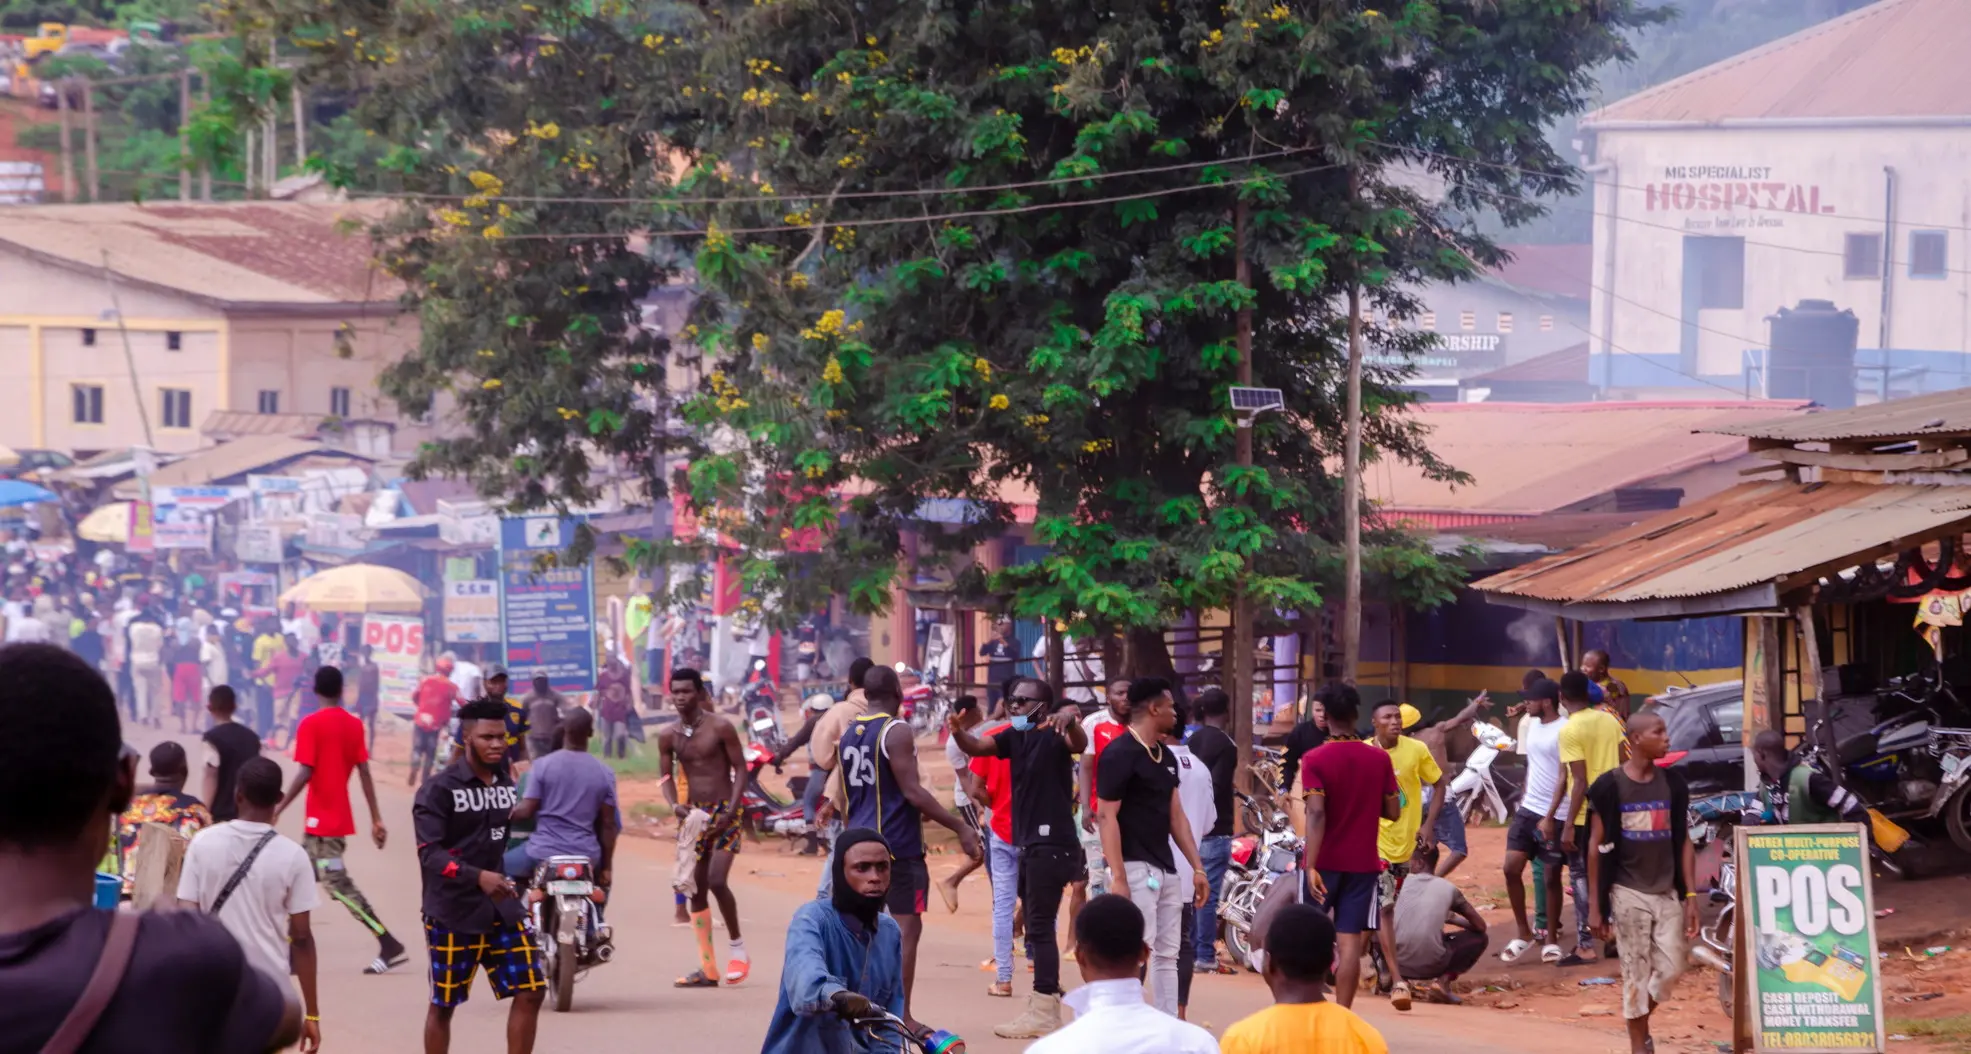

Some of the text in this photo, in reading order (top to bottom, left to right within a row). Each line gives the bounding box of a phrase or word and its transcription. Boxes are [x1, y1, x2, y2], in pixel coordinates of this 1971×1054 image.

[1689, 165, 1772, 179] SPECIALIST
[1646, 183, 1835, 213] HOSPITAL
[1431, 335, 1500, 351] ORSHIP
[366, 621, 424, 656] POS
[843, 745, 876, 787] 25
[1770, 849, 1840, 860] CO-OPERATIVE
[1755, 864, 1865, 936] POS
[1762, 992, 1839, 1004] CASH DEPOSIT
[1763, 1003, 1871, 1015] CASH WITHDRAWAL
[1764, 1015, 1859, 1027] MONEY TRANSFER
